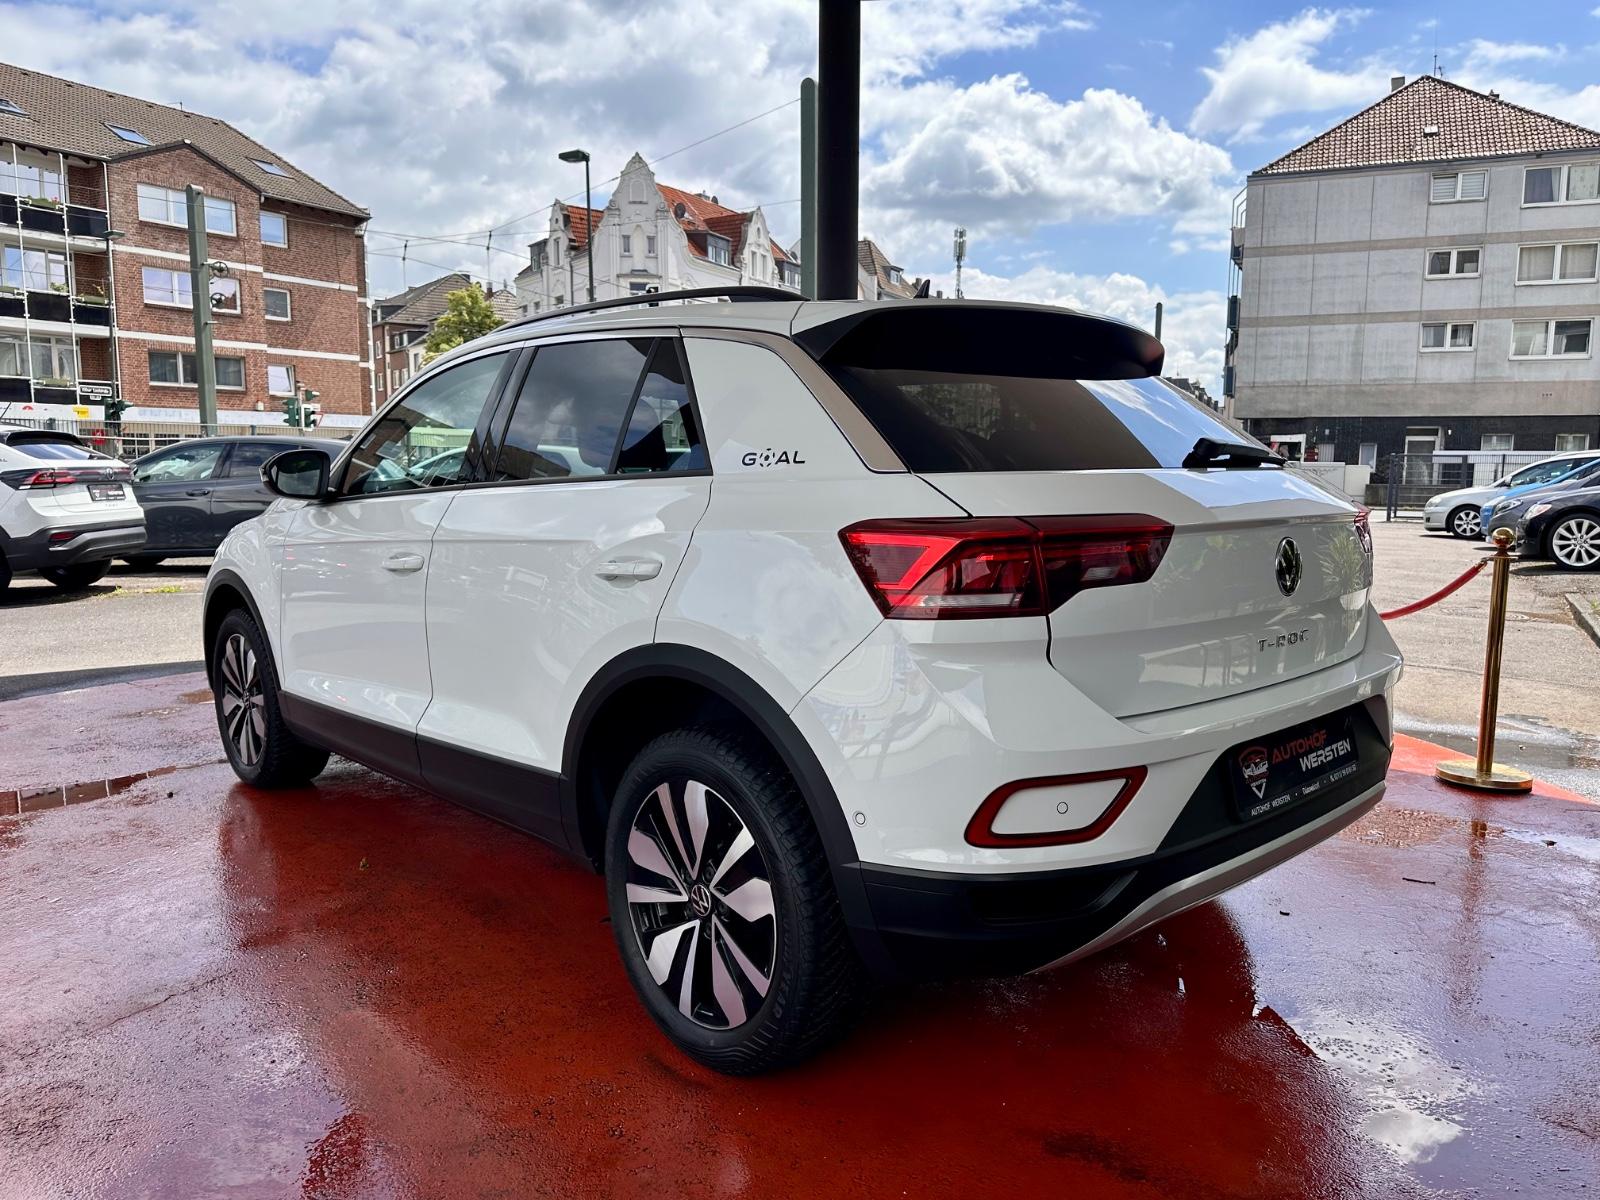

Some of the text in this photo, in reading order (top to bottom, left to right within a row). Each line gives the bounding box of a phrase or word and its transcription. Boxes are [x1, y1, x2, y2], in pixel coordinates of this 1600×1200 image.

[741, 448, 806, 467] GOAL
[1258, 629, 1309, 652] T-ROC
[1272, 730, 1327, 763] AUTOHOF
[1299, 738, 1352, 772] WERSTEN
